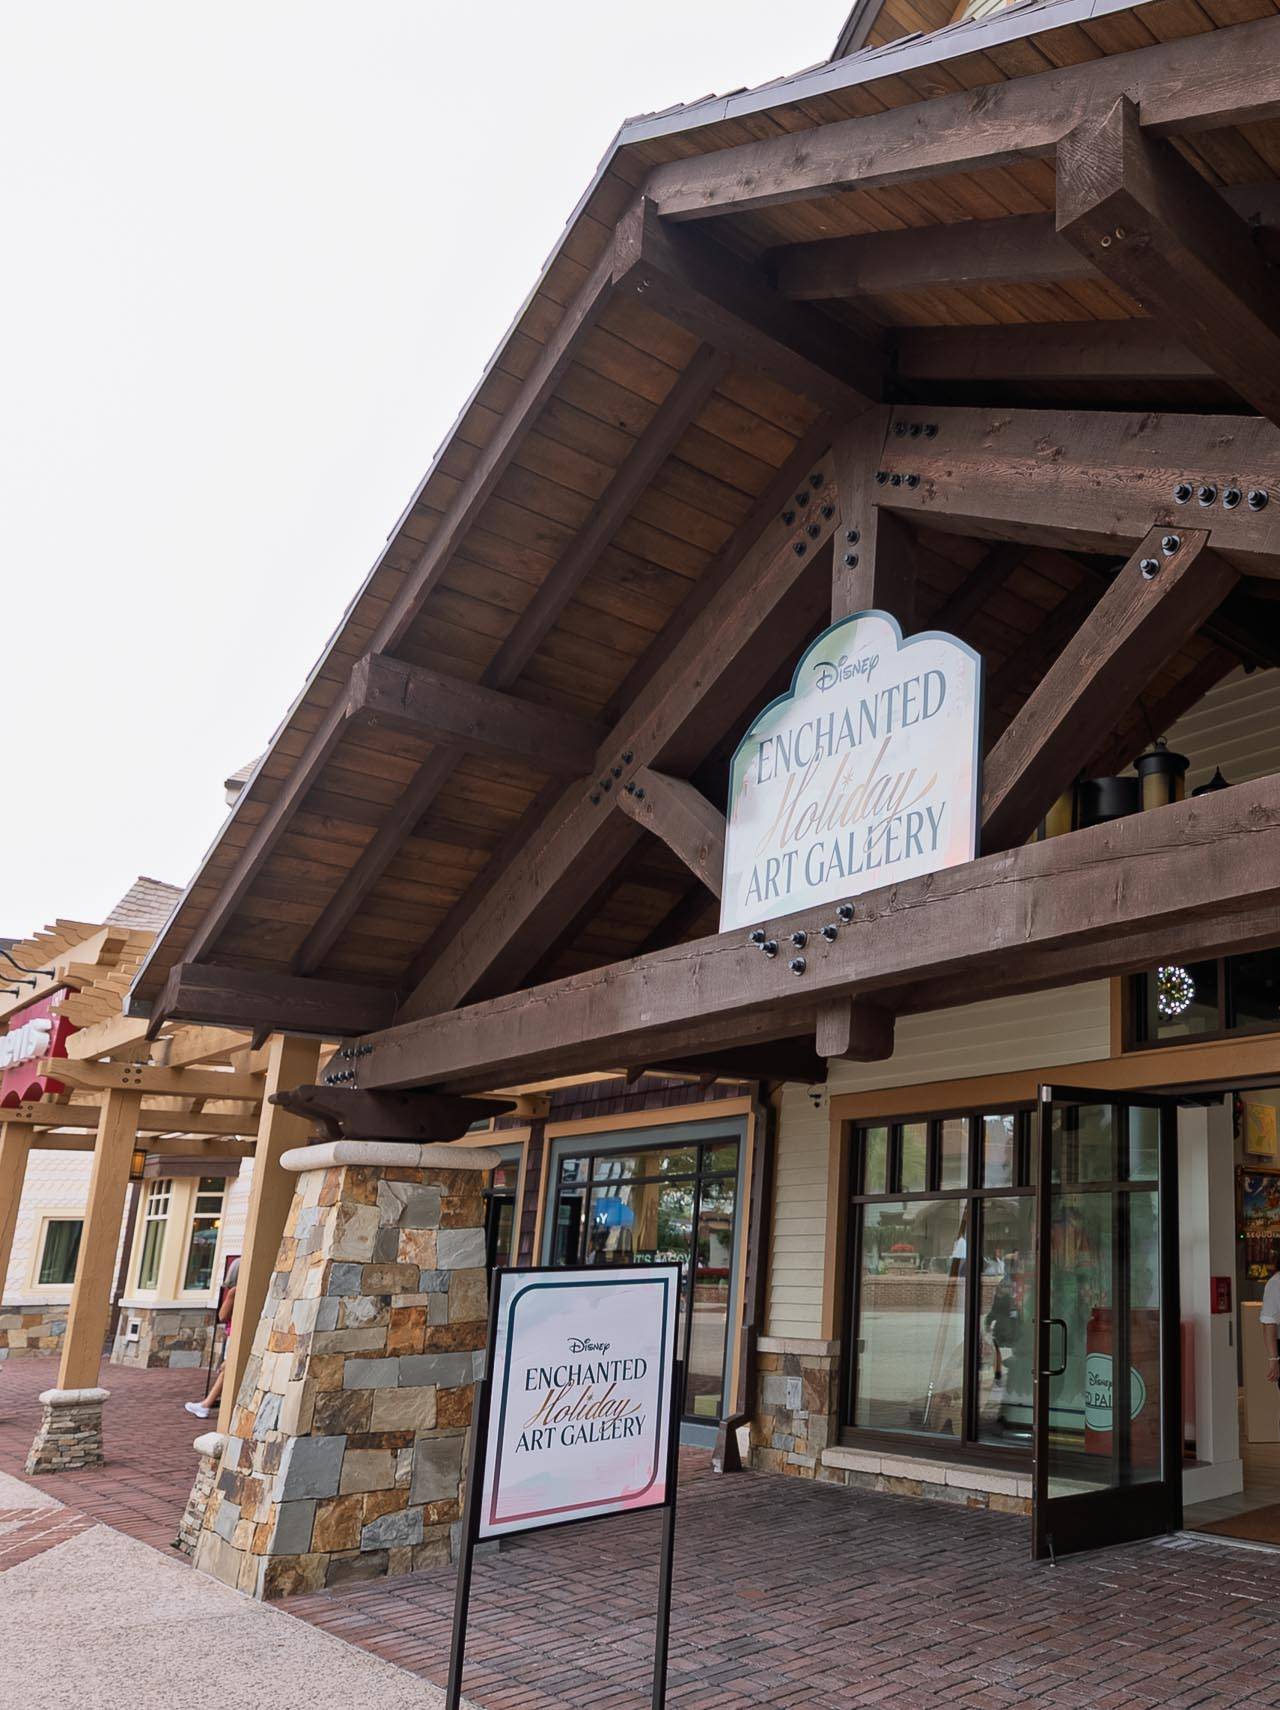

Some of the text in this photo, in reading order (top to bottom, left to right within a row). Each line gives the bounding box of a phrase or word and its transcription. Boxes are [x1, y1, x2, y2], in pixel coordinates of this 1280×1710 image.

[813, 654, 880, 692] Disney
[757, 669, 947, 785] ENCHANTED
[756, 736, 939, 856] Holiday
[744, 801, 946, 906] ART GALLERY
[567, 1337, 611, 1355] Disney
[525, 1358, 647, 1391] ENCHANTED
[523, 1379, 642, 1433] Holiday
[515, 1415, 647, 1453] ART GALLERY
